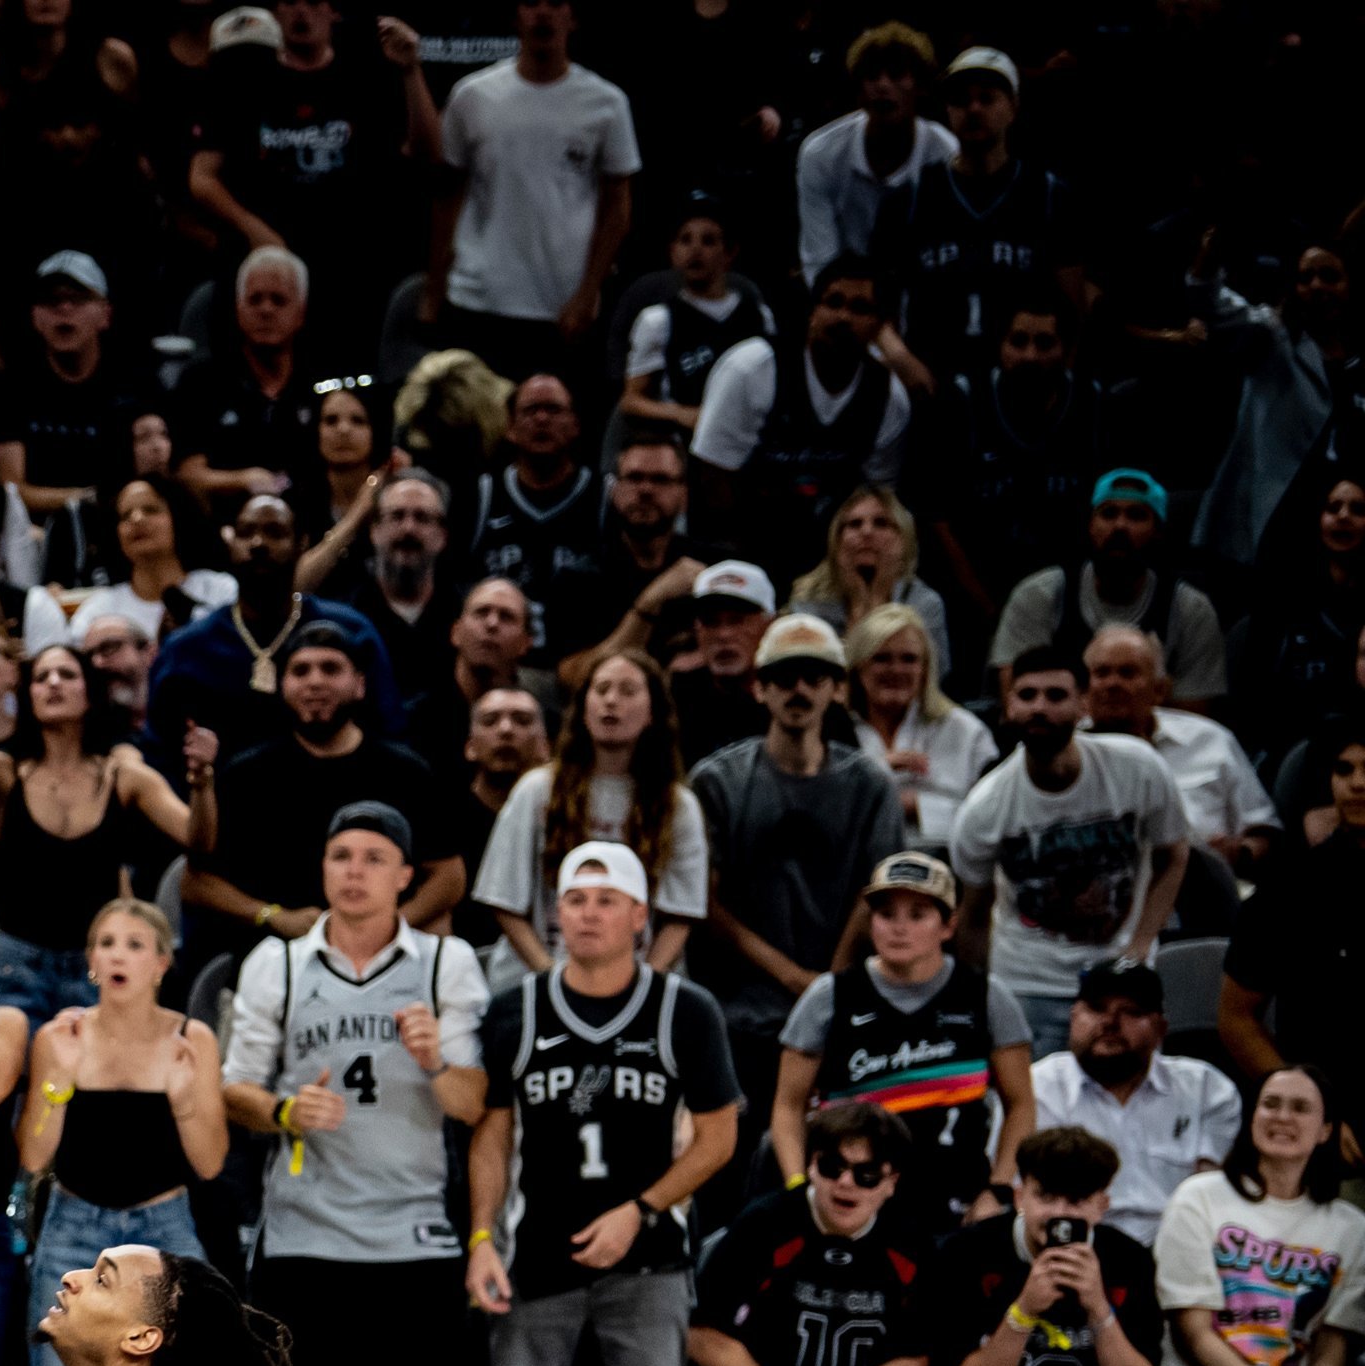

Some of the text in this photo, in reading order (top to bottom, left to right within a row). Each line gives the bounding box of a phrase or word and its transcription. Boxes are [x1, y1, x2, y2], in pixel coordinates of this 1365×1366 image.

[919, 240, 1034, 272] SPRS
[295, 1013, 399, 1060] SAN ANTO
[343, 1054, 378, 1105] 4
[524, 1065, 667, 1116] SPURS
[579, 1122, 609, 1180] 1
[1213, 1223, 1340, 1288] SPURS
